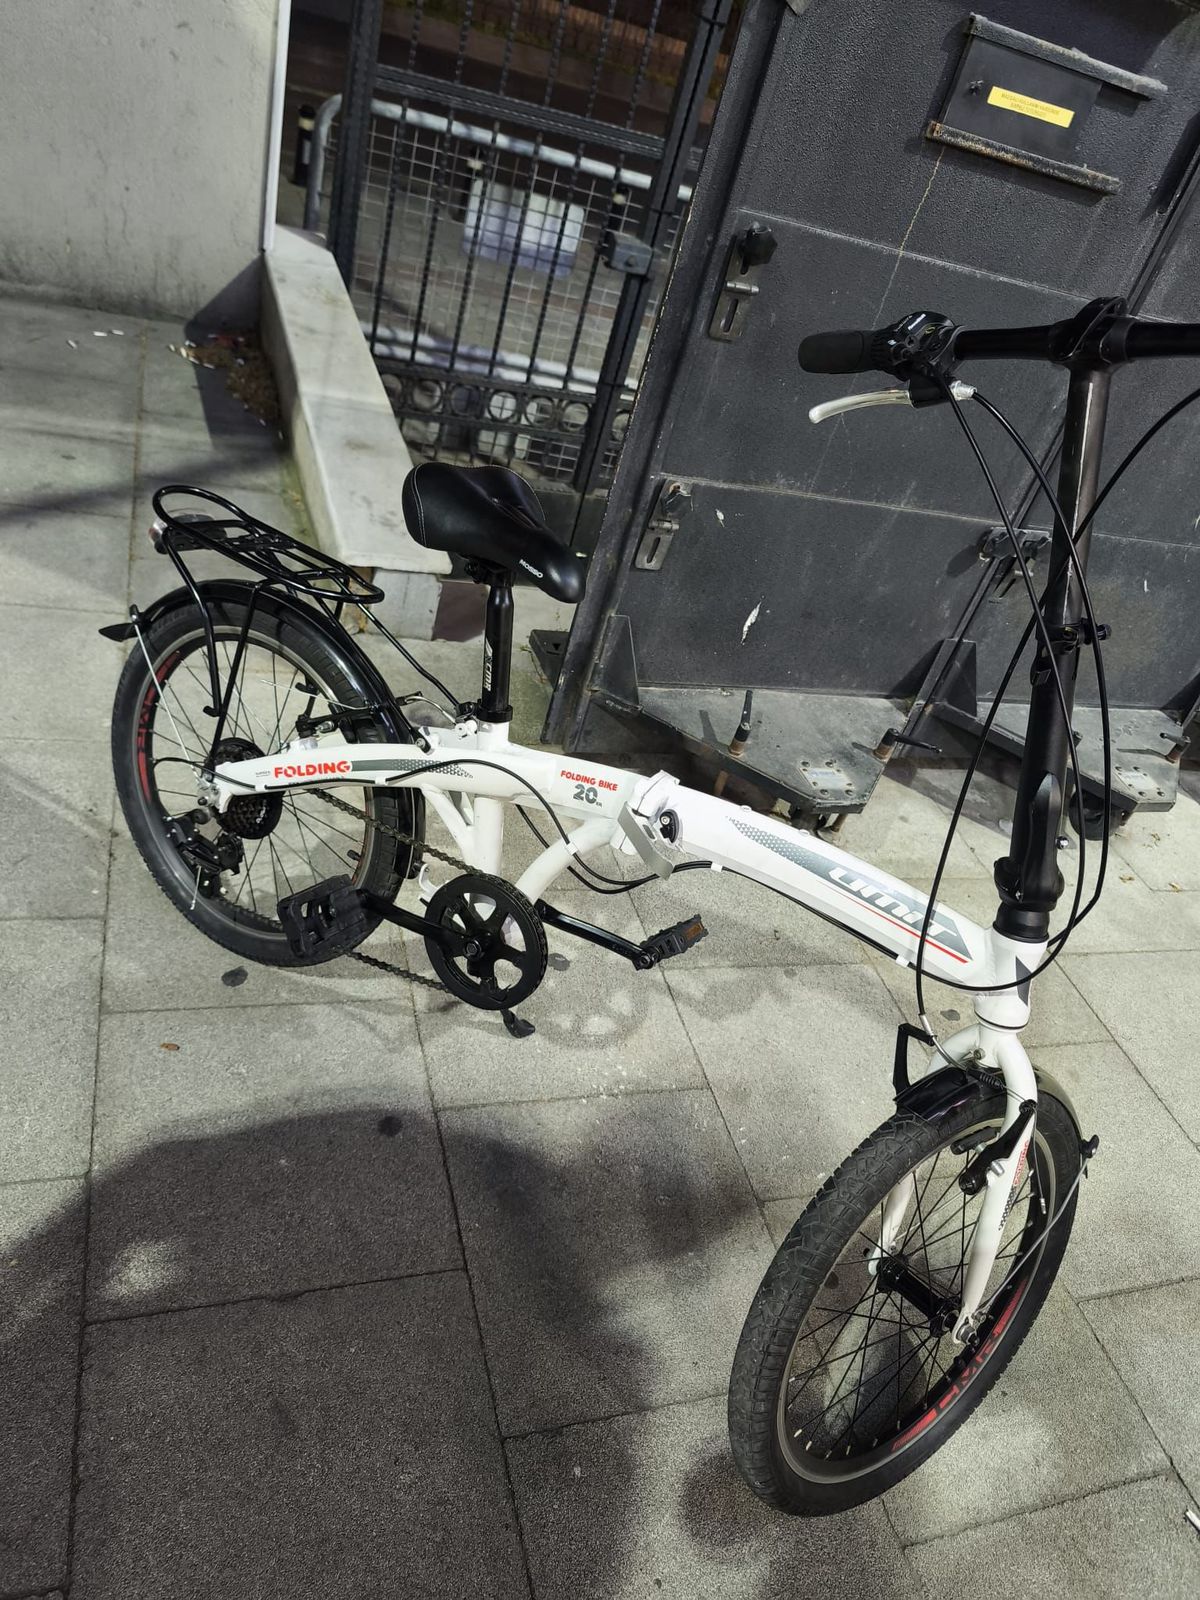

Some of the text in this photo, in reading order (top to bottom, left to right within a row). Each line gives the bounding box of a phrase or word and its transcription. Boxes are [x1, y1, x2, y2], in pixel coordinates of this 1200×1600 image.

[274, 761, 351, 778] FOLDING
[560, 770, 619, 792] FOLDING BIKE
[572, 783, 598, 804] 20
